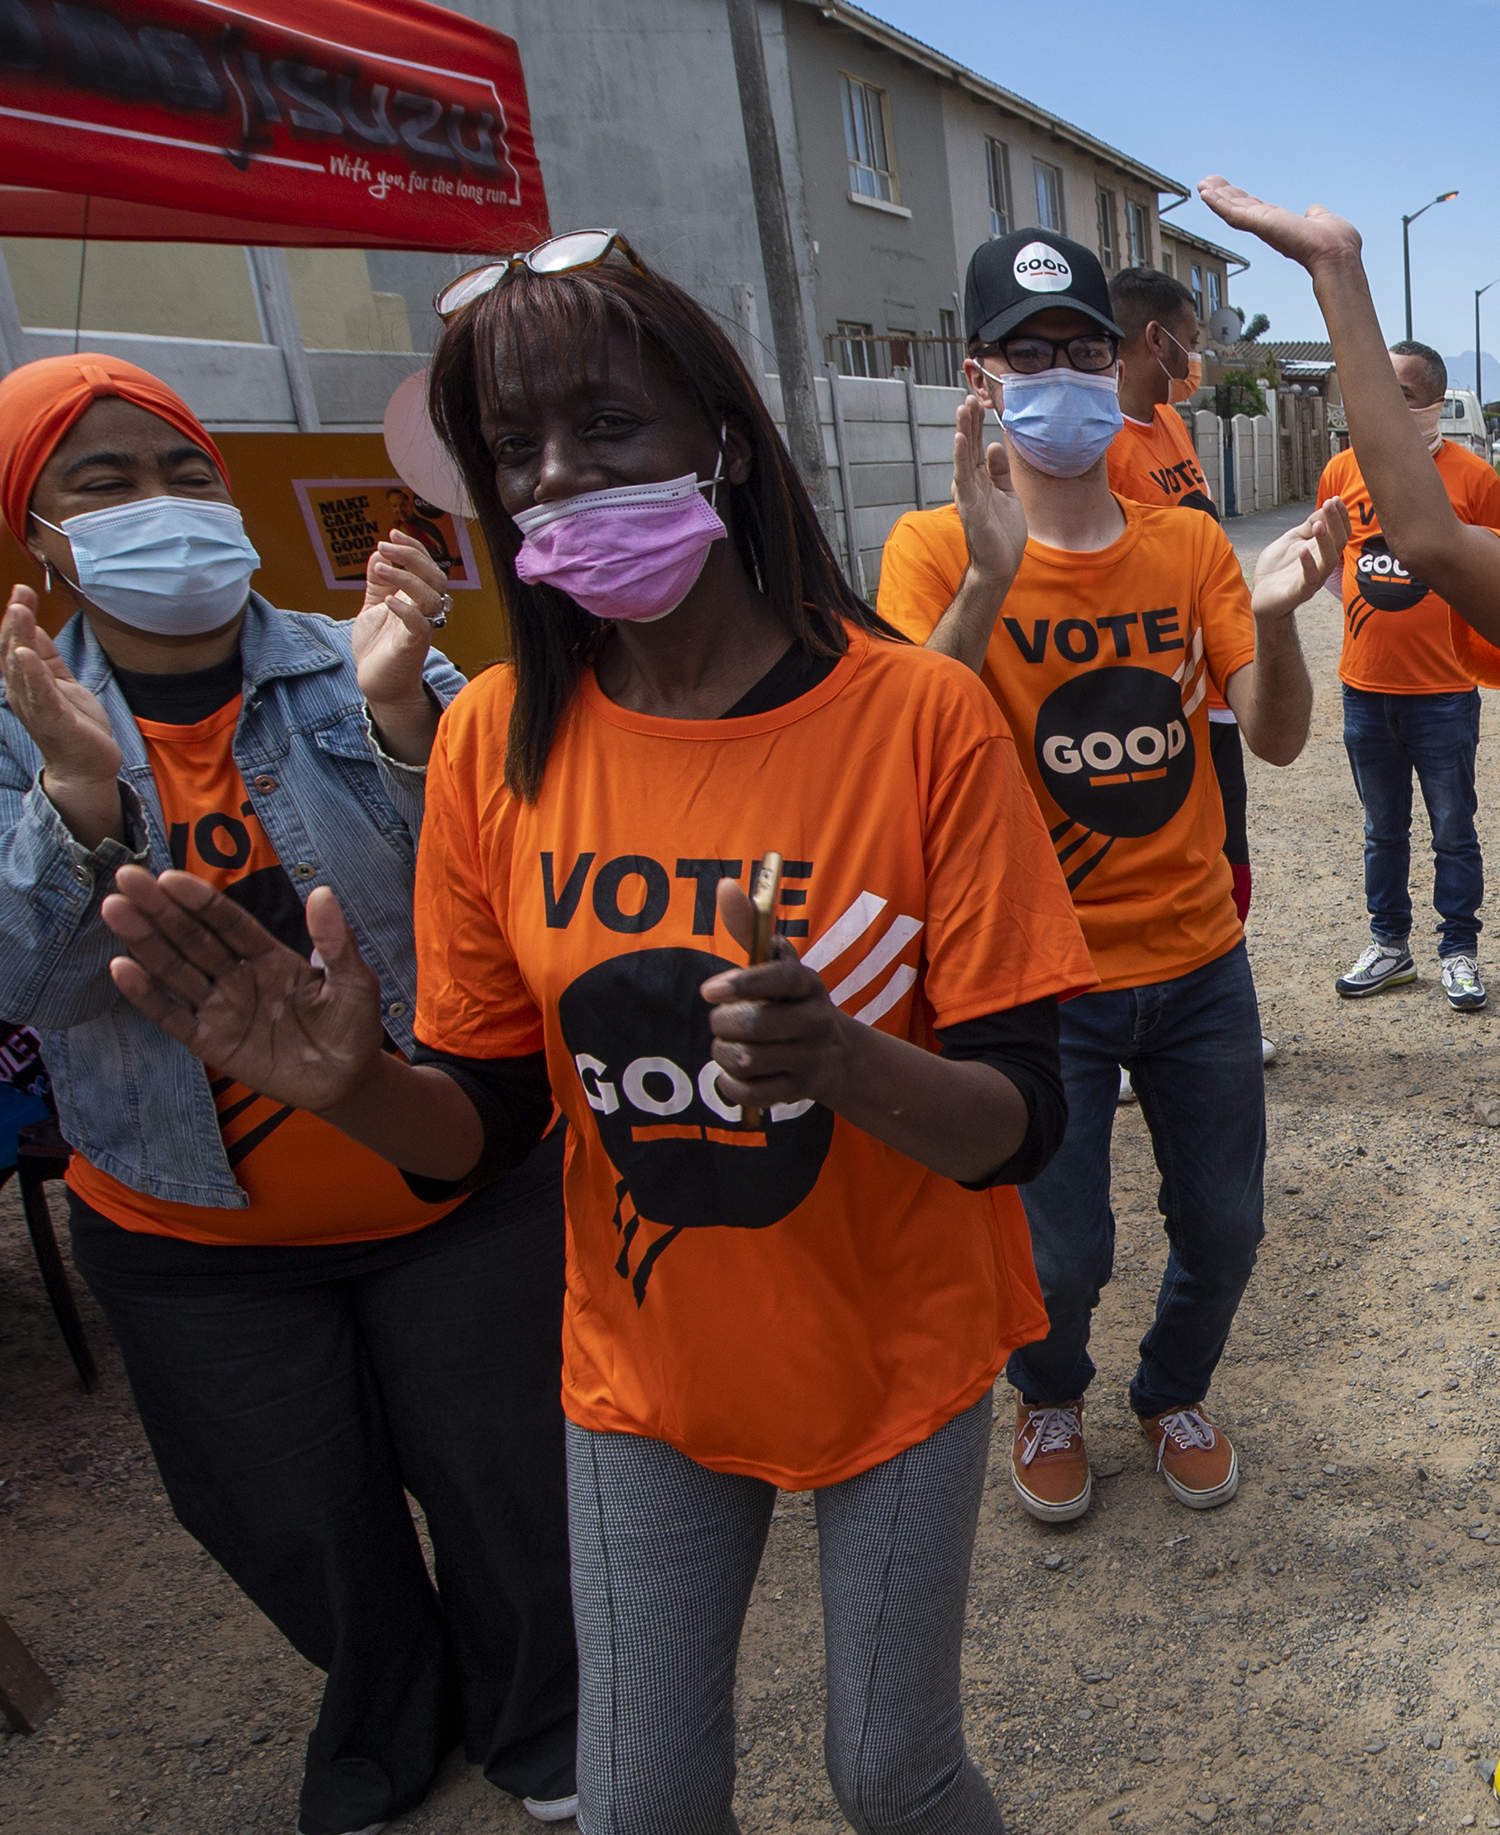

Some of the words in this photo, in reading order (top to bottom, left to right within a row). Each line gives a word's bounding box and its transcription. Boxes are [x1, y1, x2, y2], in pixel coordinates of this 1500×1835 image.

[330, 154, 372, 183] With
[368, 170, 405, 200] you,
[407, 171, 428, 194] for
[431, 176, 453, 195] the
[456, 179, 484, 206] long
[486, 189, 508, 204] run
[1016, 258, 1069, 275] GOOD
[1149, 459, 1205, 495] VOTE
[318, 495, 370, 516] MAKE
[323, 509, 366, 528] CAPE
[326, 520, 379, 541] TOWN
[330, 535, 375, 554] GOOD
[1358, 553, 1409, 577] GOO
[1001, 606, 1185, 664] VOTE
[1042, 719, 1186, 774] GOOD
[540, 851, 814, 937] VOTE
[575, 1053, 816, 1123] GOO
